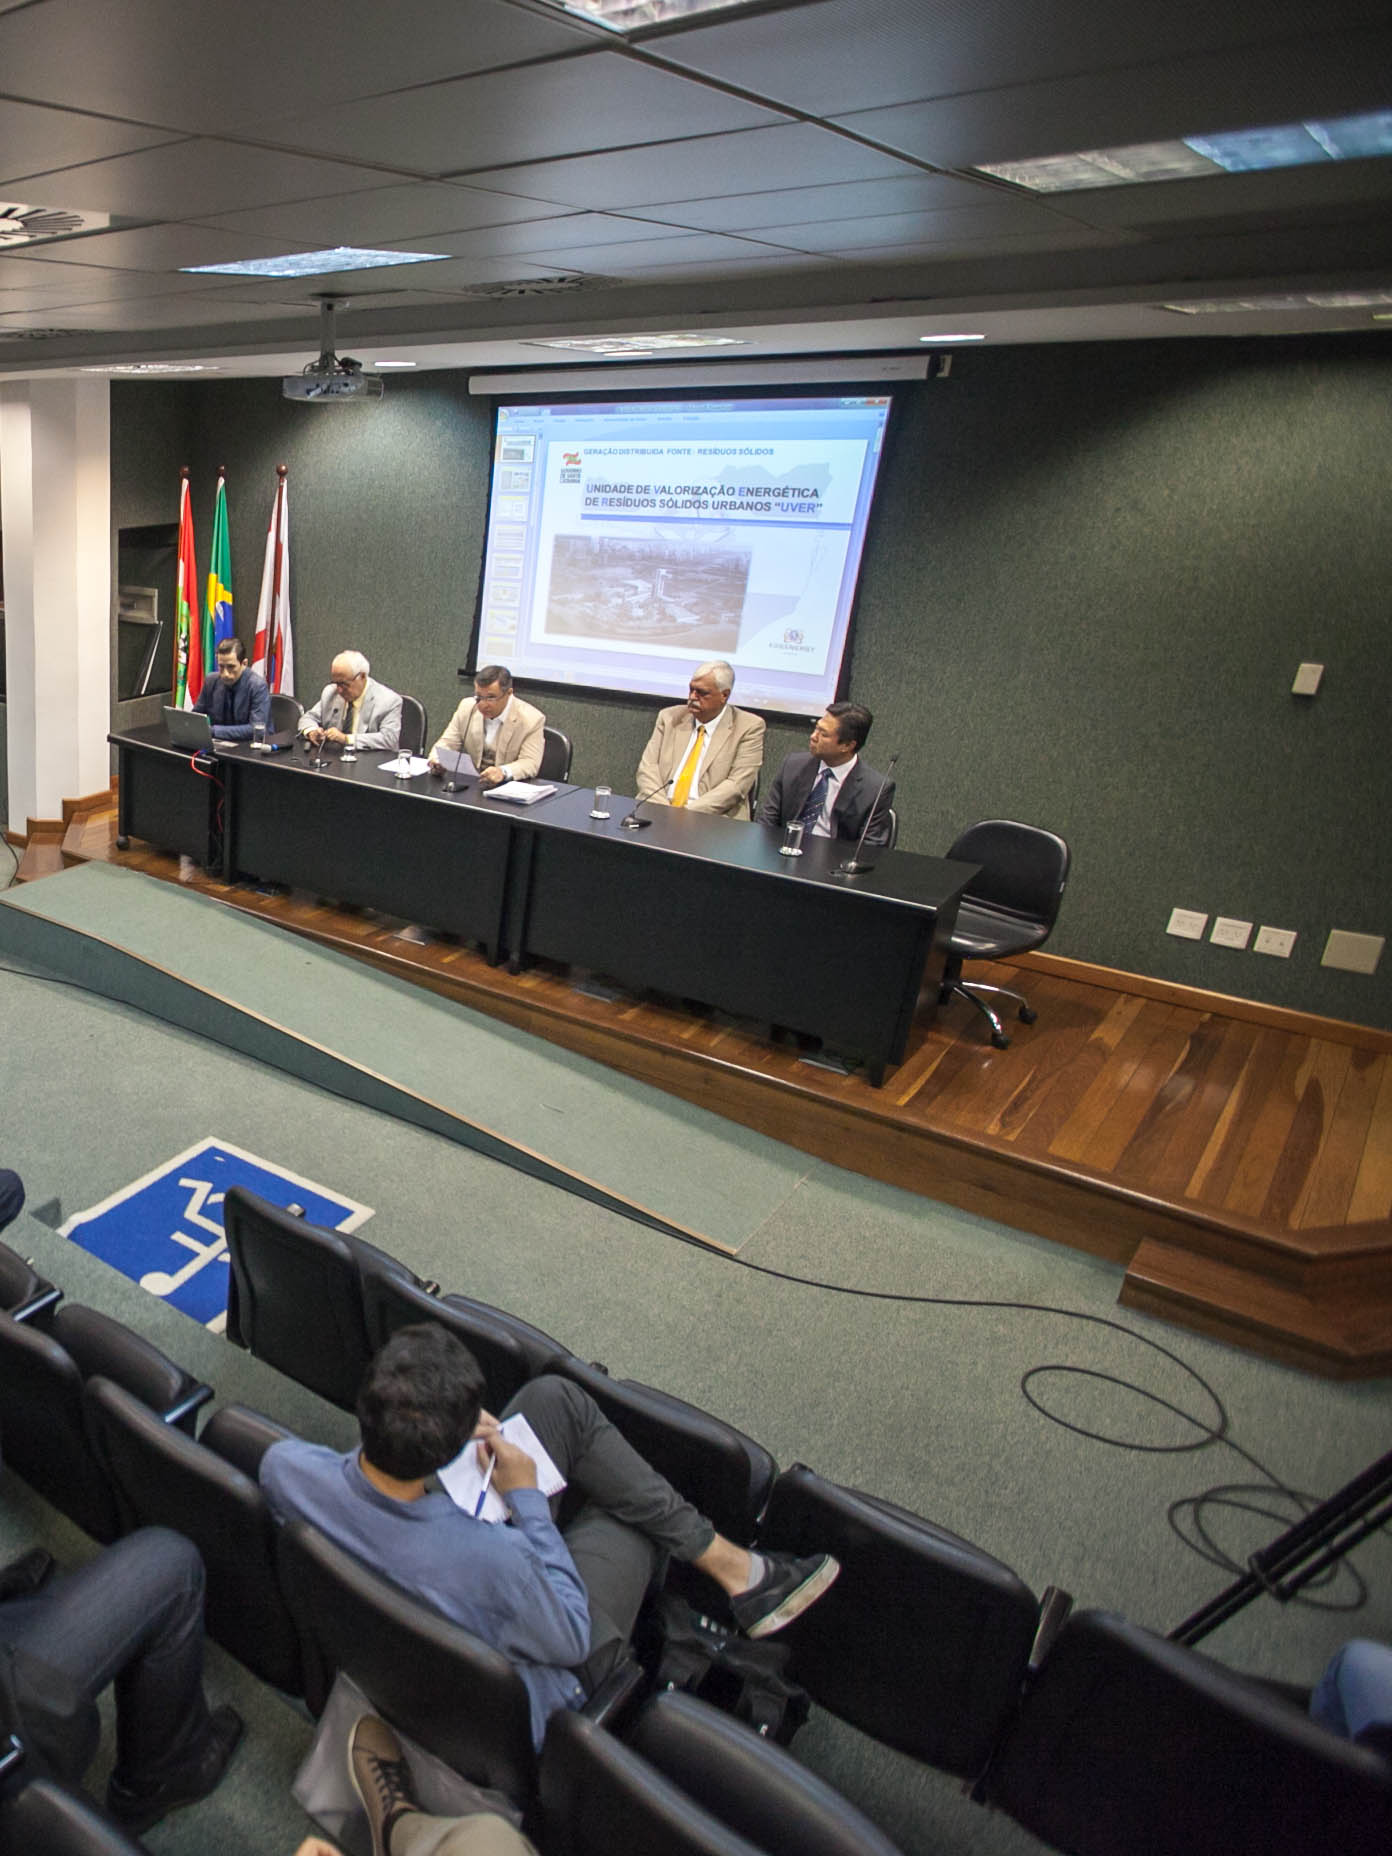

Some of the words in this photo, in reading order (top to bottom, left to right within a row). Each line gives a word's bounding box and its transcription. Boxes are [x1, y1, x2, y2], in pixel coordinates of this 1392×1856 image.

[583, 447, 618, 456] GERAÇÃO
[738, 447, 774, 455] SÓLIDOS
[586, 484, 634, 494] UNIDADE
[635, 484, 651, 495] DE
[653, 484, 735, 497] VALORIZAÇÃO
[738, 486, 820, 498] ENERGÉTICA
[584, 497, 599, 506] DE
[601, 496, 657, 508] RESÍDUOS
[659, 496, 708, 509] SÓLIDOS
[711, 500, 772, 511] URBANOS
